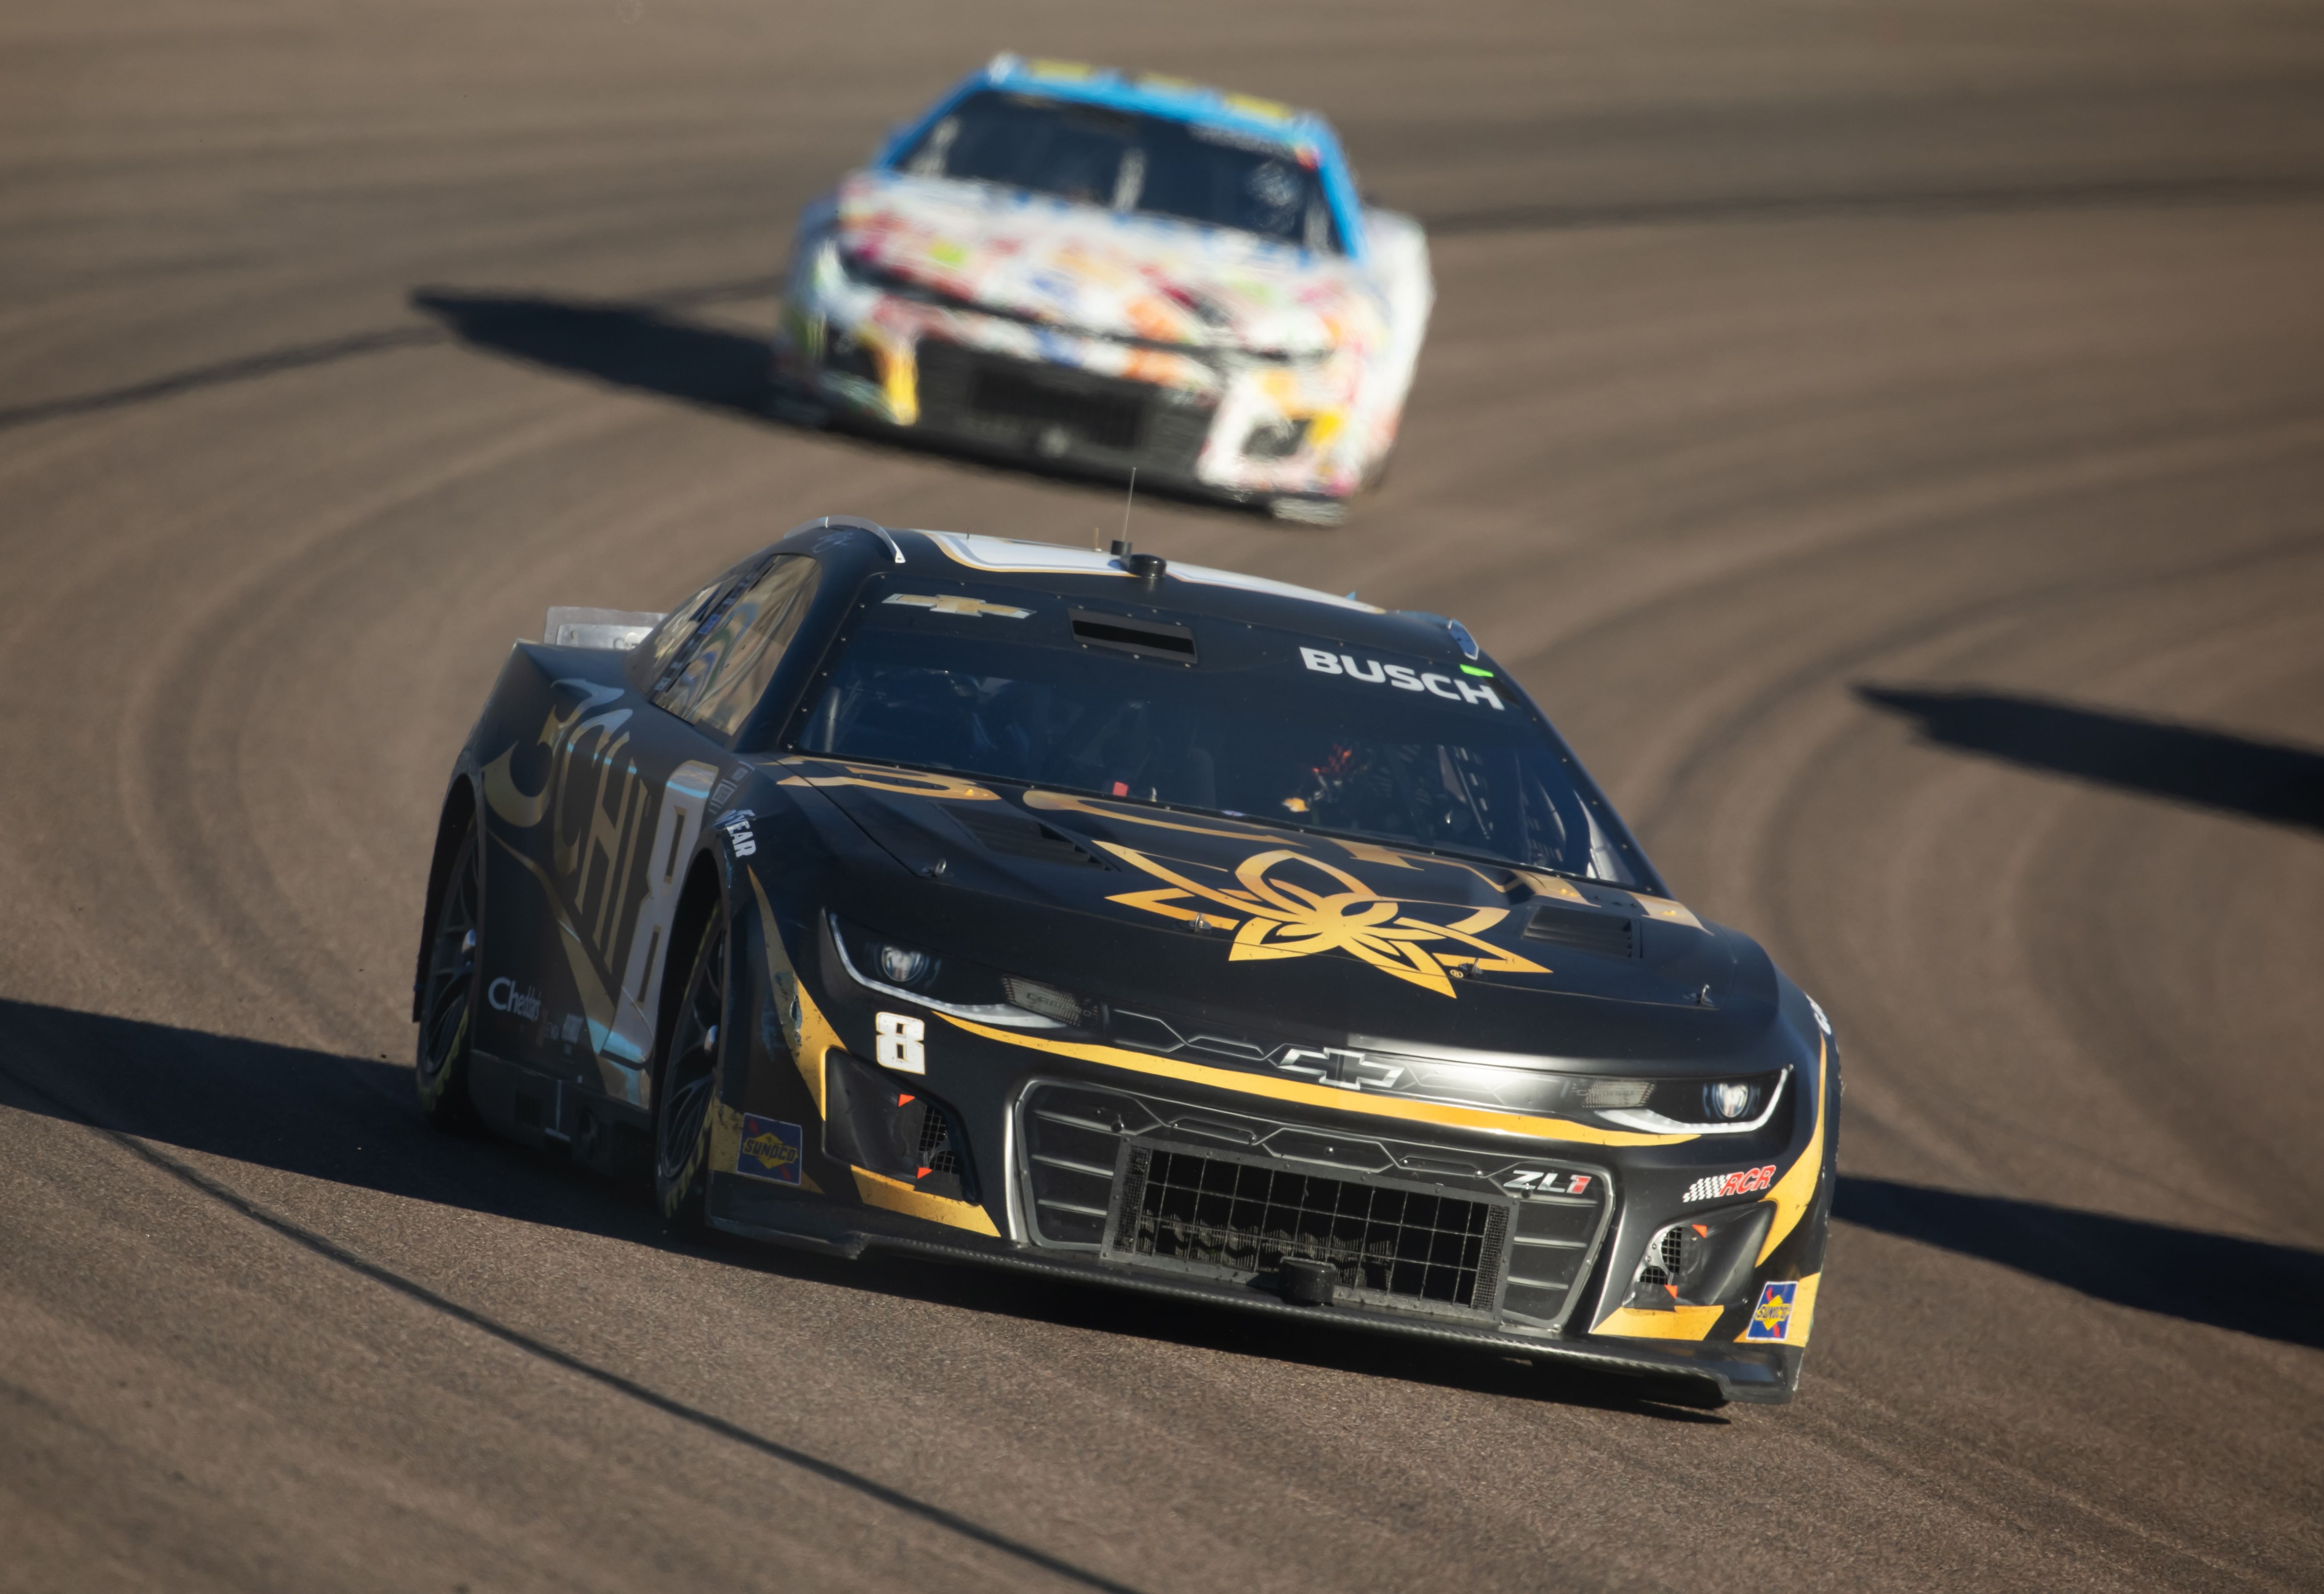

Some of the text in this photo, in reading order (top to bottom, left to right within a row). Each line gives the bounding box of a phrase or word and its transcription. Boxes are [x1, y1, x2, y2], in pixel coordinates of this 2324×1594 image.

[1299, 647, 1505, 711] BUSCH
[876, 1011, 926, 1075] 8
[745, 1138, 797, 1162] SUNOCO
[1503, 1169, 1592, 1194] ZL1
[1719, 1165, 1776, 1197] RCR
